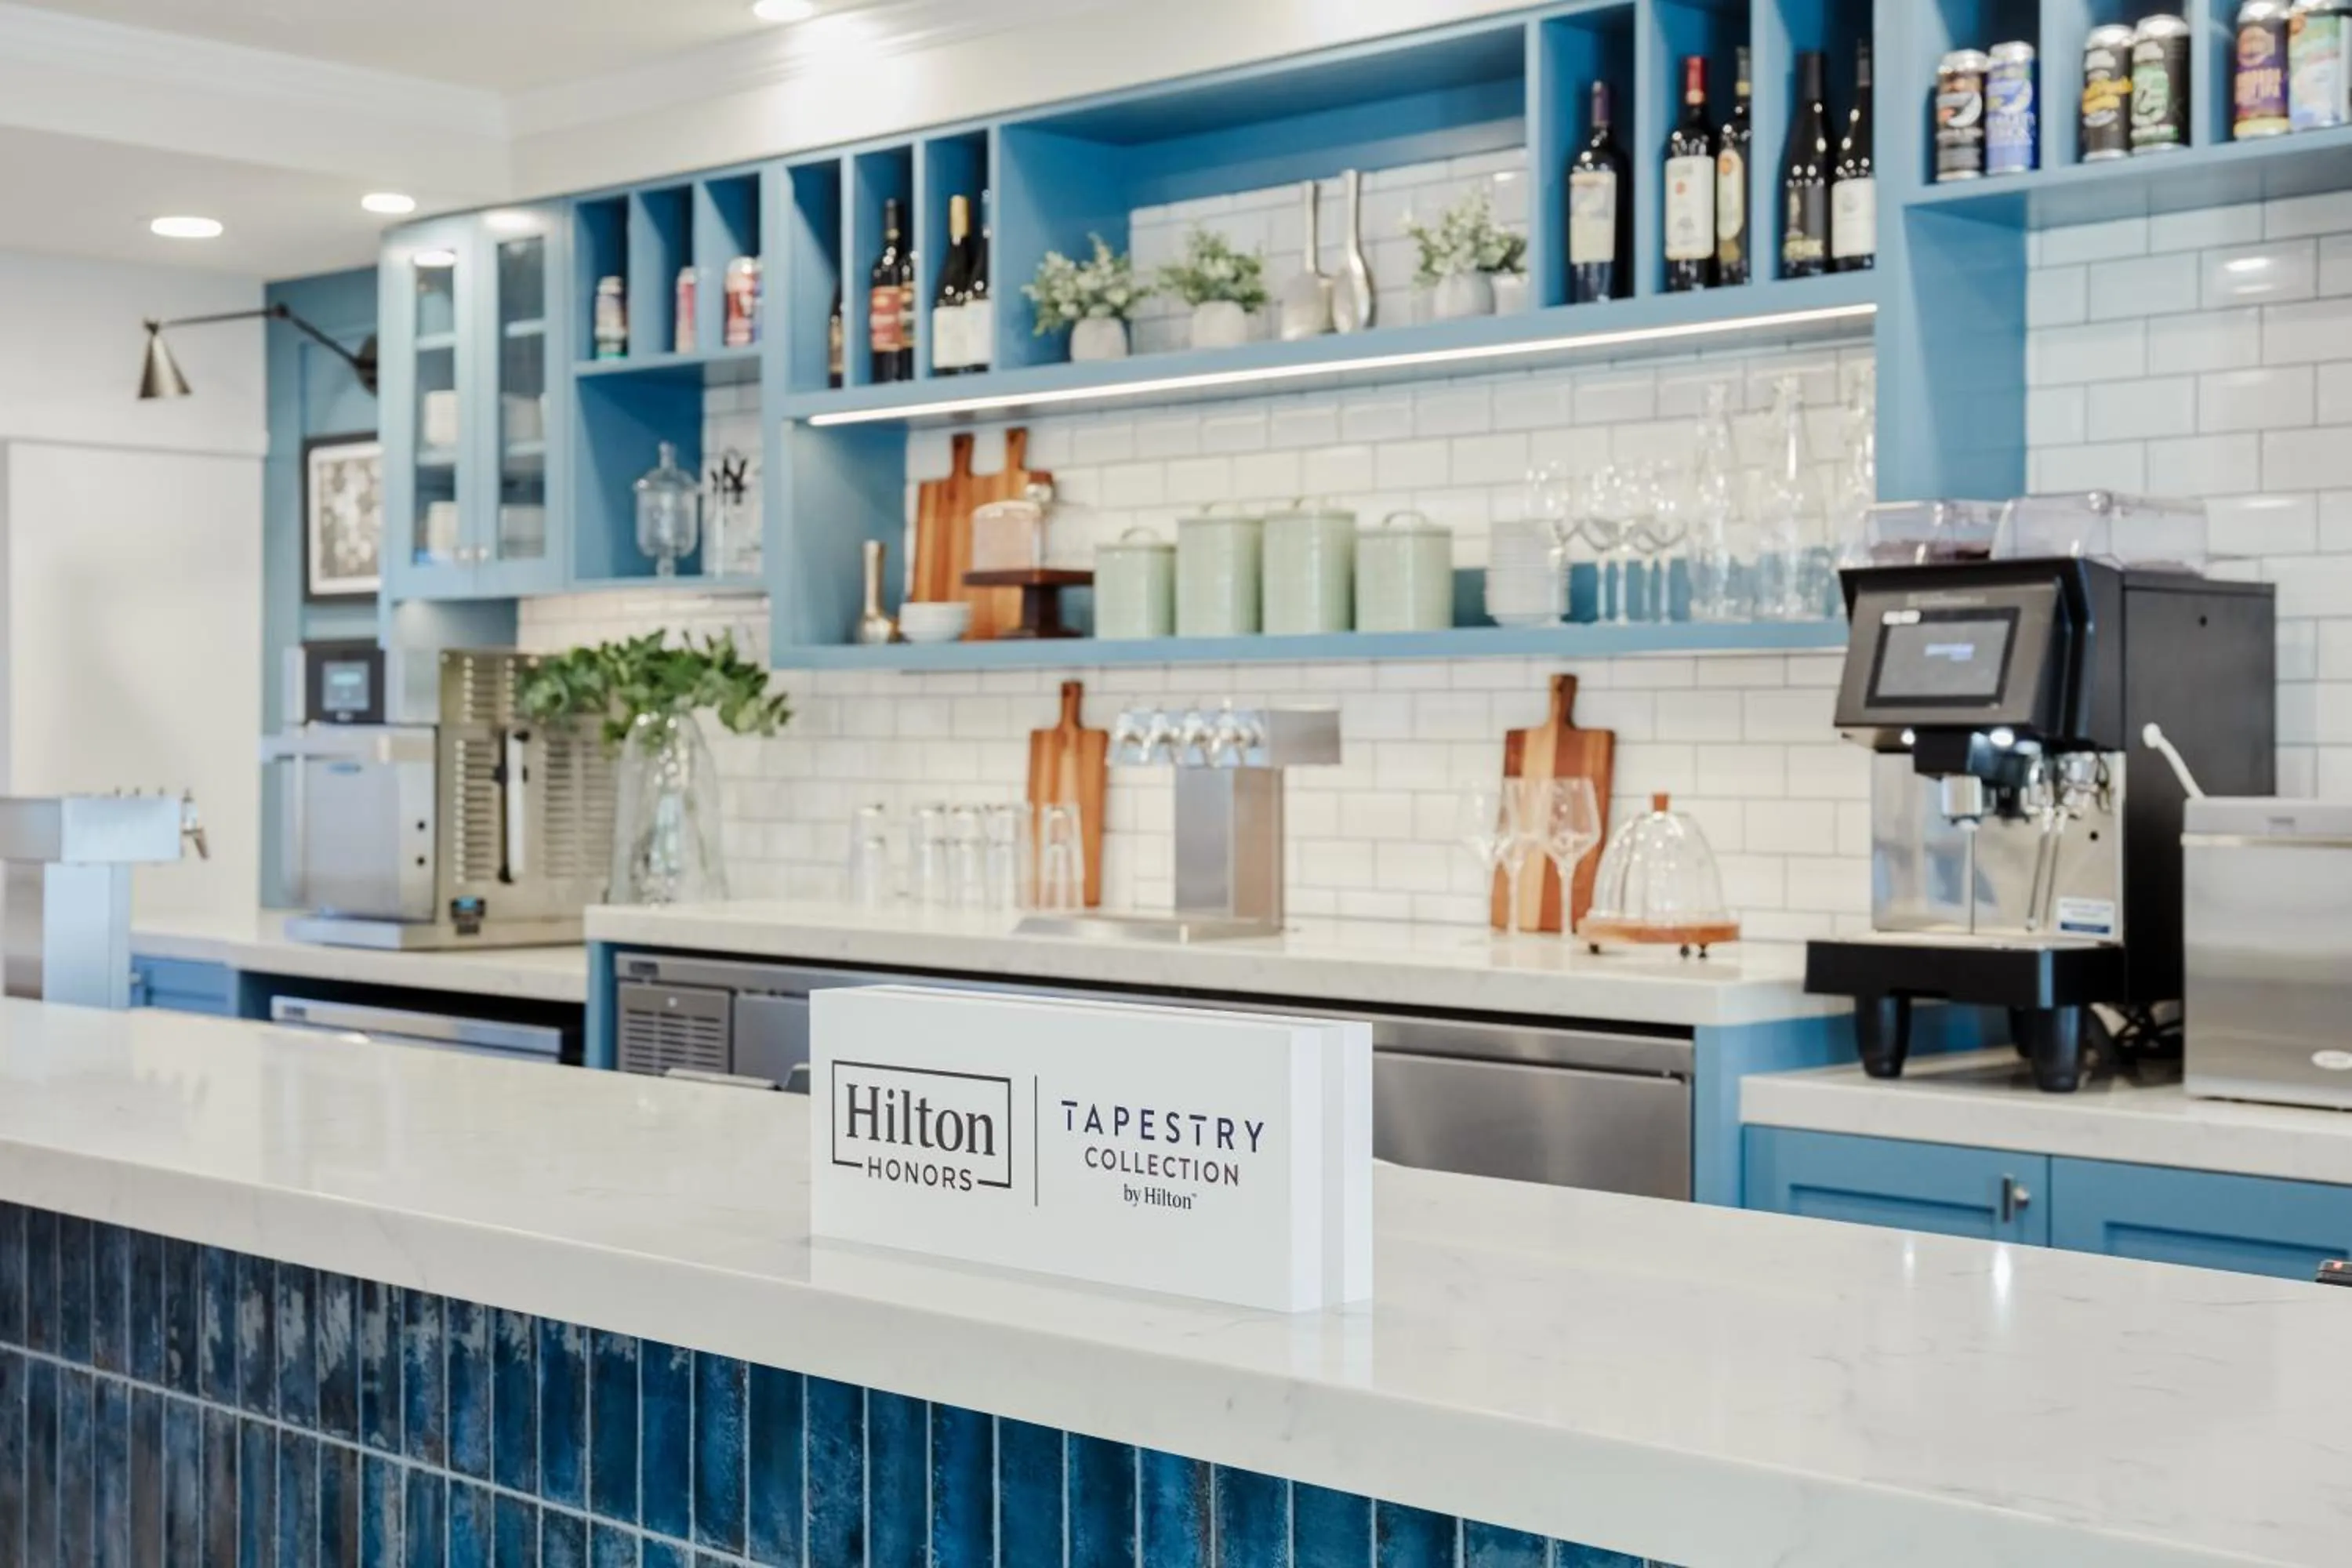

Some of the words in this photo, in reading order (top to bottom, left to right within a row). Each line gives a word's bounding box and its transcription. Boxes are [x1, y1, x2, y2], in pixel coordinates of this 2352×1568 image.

[846, 1083, 996, 1156] Hilton
[1061, 1100, 1265, 1153] TAPESTRY
[868, 1156, 973, 1192] HONORS
[1084, 1146, 1239, 1187] COLLECTION
[1123, 1183, 1142, 1207] by
